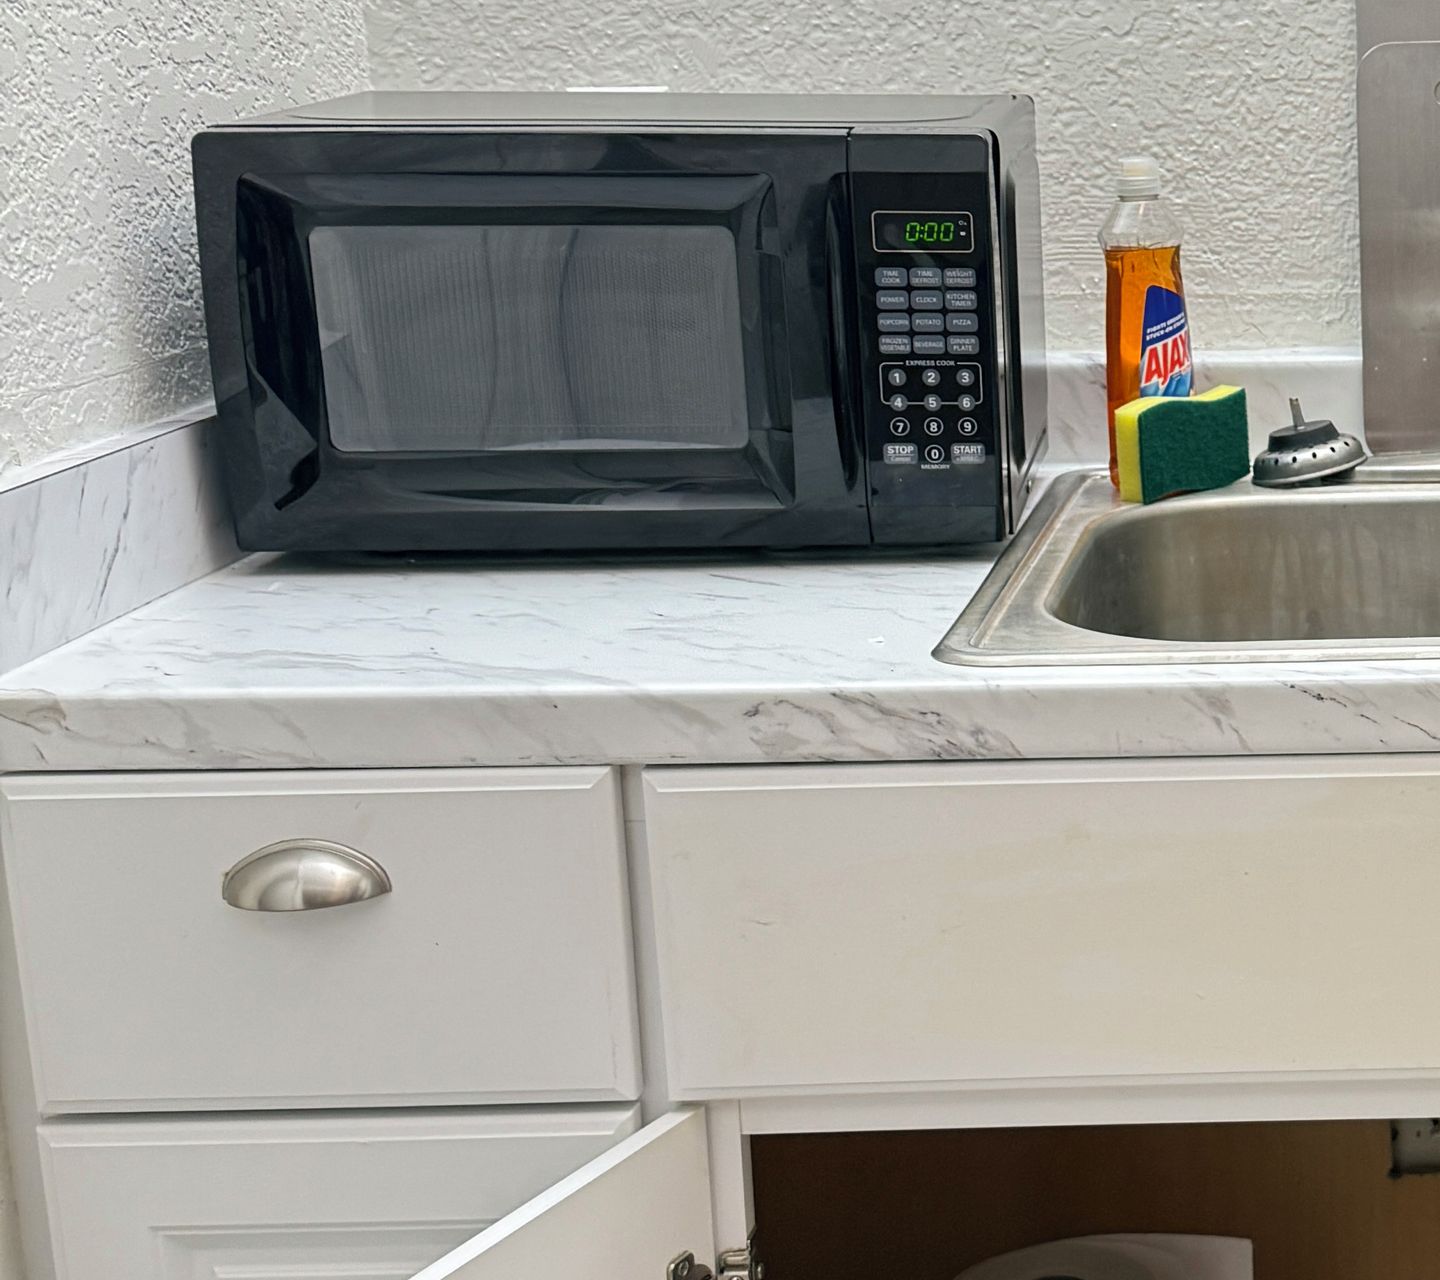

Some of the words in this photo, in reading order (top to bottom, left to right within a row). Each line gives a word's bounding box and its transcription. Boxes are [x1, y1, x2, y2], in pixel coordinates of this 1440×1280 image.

[905, 222, 954, 242] 0:00
[1143, 329, 1190, 386] AJAX
[893, 372, 900, 384] 1
[927, 372, 936, 383] 2
[961, 372, 970, 383] 3
[894, 397, 903, 408] 4
[928, 397, 937, 408] 5
[962, 397, 971, 408] 6
[896, 422, 904, 433] 7
[929, 421, 938, 432] 8
[963, 421, 972, 432] 9
[887, 445, 914, 454] STOP
[931, 449, 939, 460] 0
[953, 445, 982, 454] START
